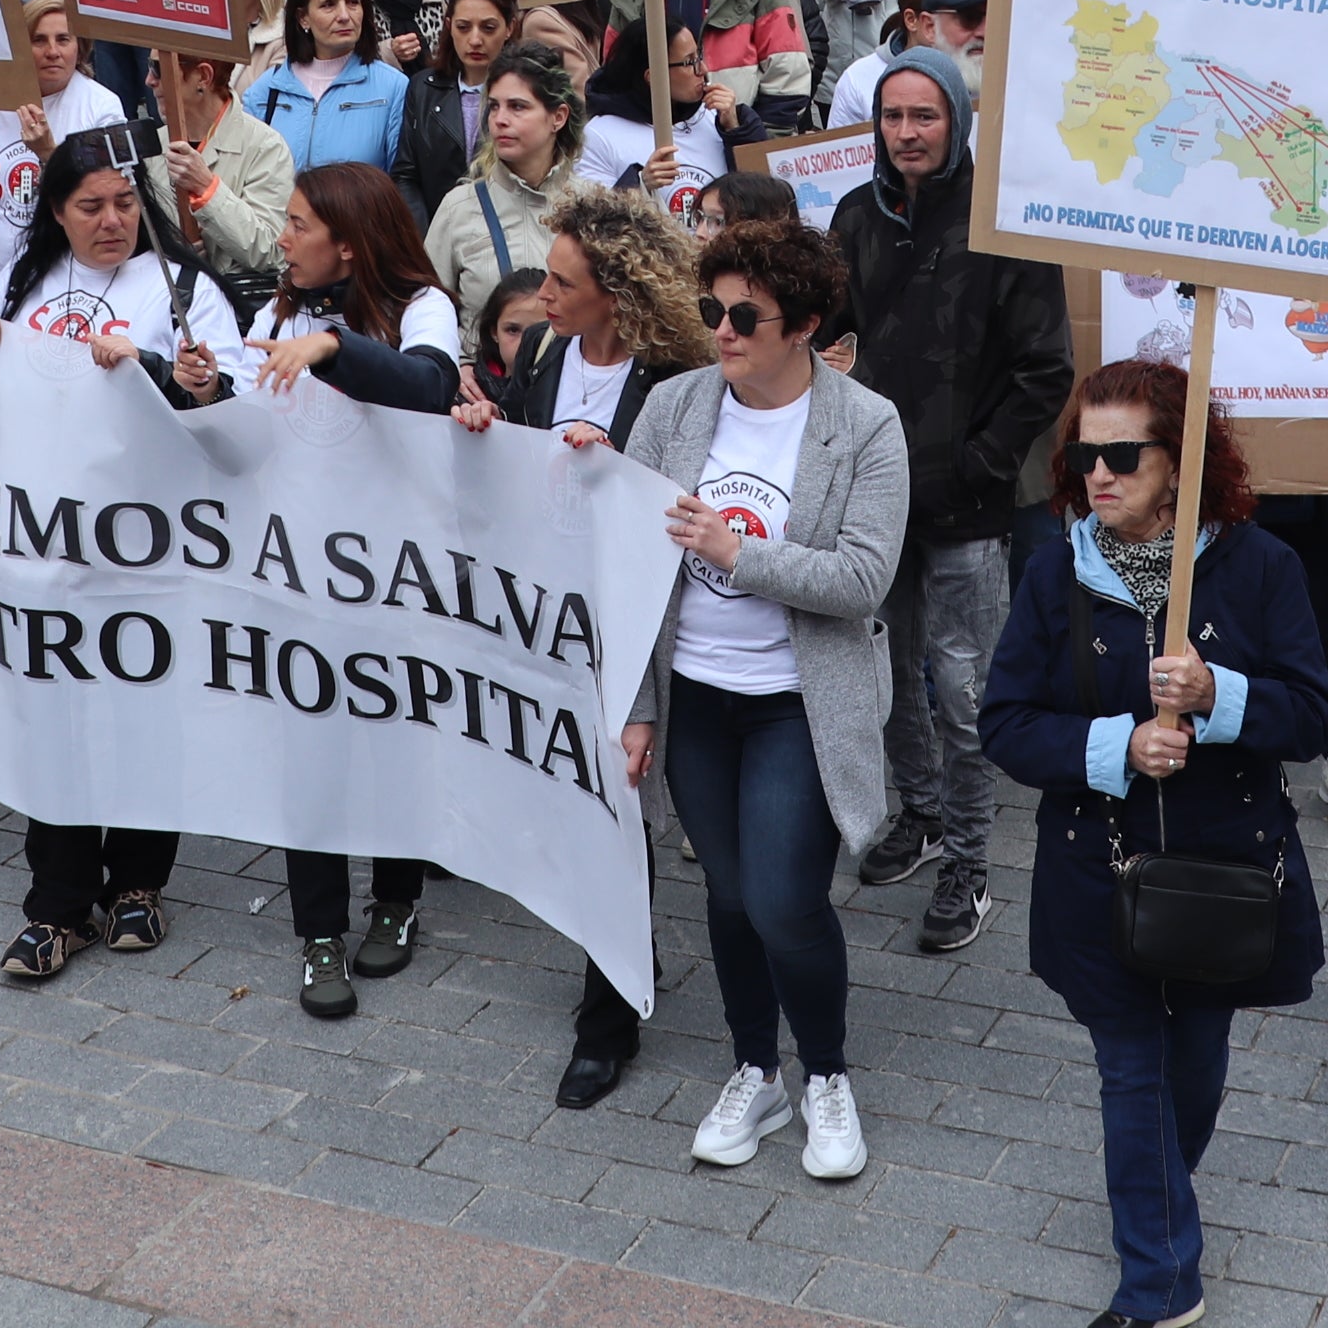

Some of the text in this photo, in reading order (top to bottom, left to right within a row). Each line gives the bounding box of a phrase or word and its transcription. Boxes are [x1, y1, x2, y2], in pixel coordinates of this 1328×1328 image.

[794, 152, 843, 177] NO SOMOS
[1023, 202, 1054, 224] ¡NO
[1056, 207, 1135, 234] PERMITAS
[1138, 216, 1172, 240] QUE
[1175, 221, 1194, 241] TE
[1197, 224, 1270, 252] DERIVEN
[1271, 235, 1283, 254] A
[1237, 387, 1262, 401] HOY,
[1264, 383, 1310, 399] MAÑANA
[711, 481, 776, 510] HOSPITAL
[252, 513, 306, 594] A
[324, 531, 604, 673] SALVA
[202, 618, 616, 819] HOSPITA
